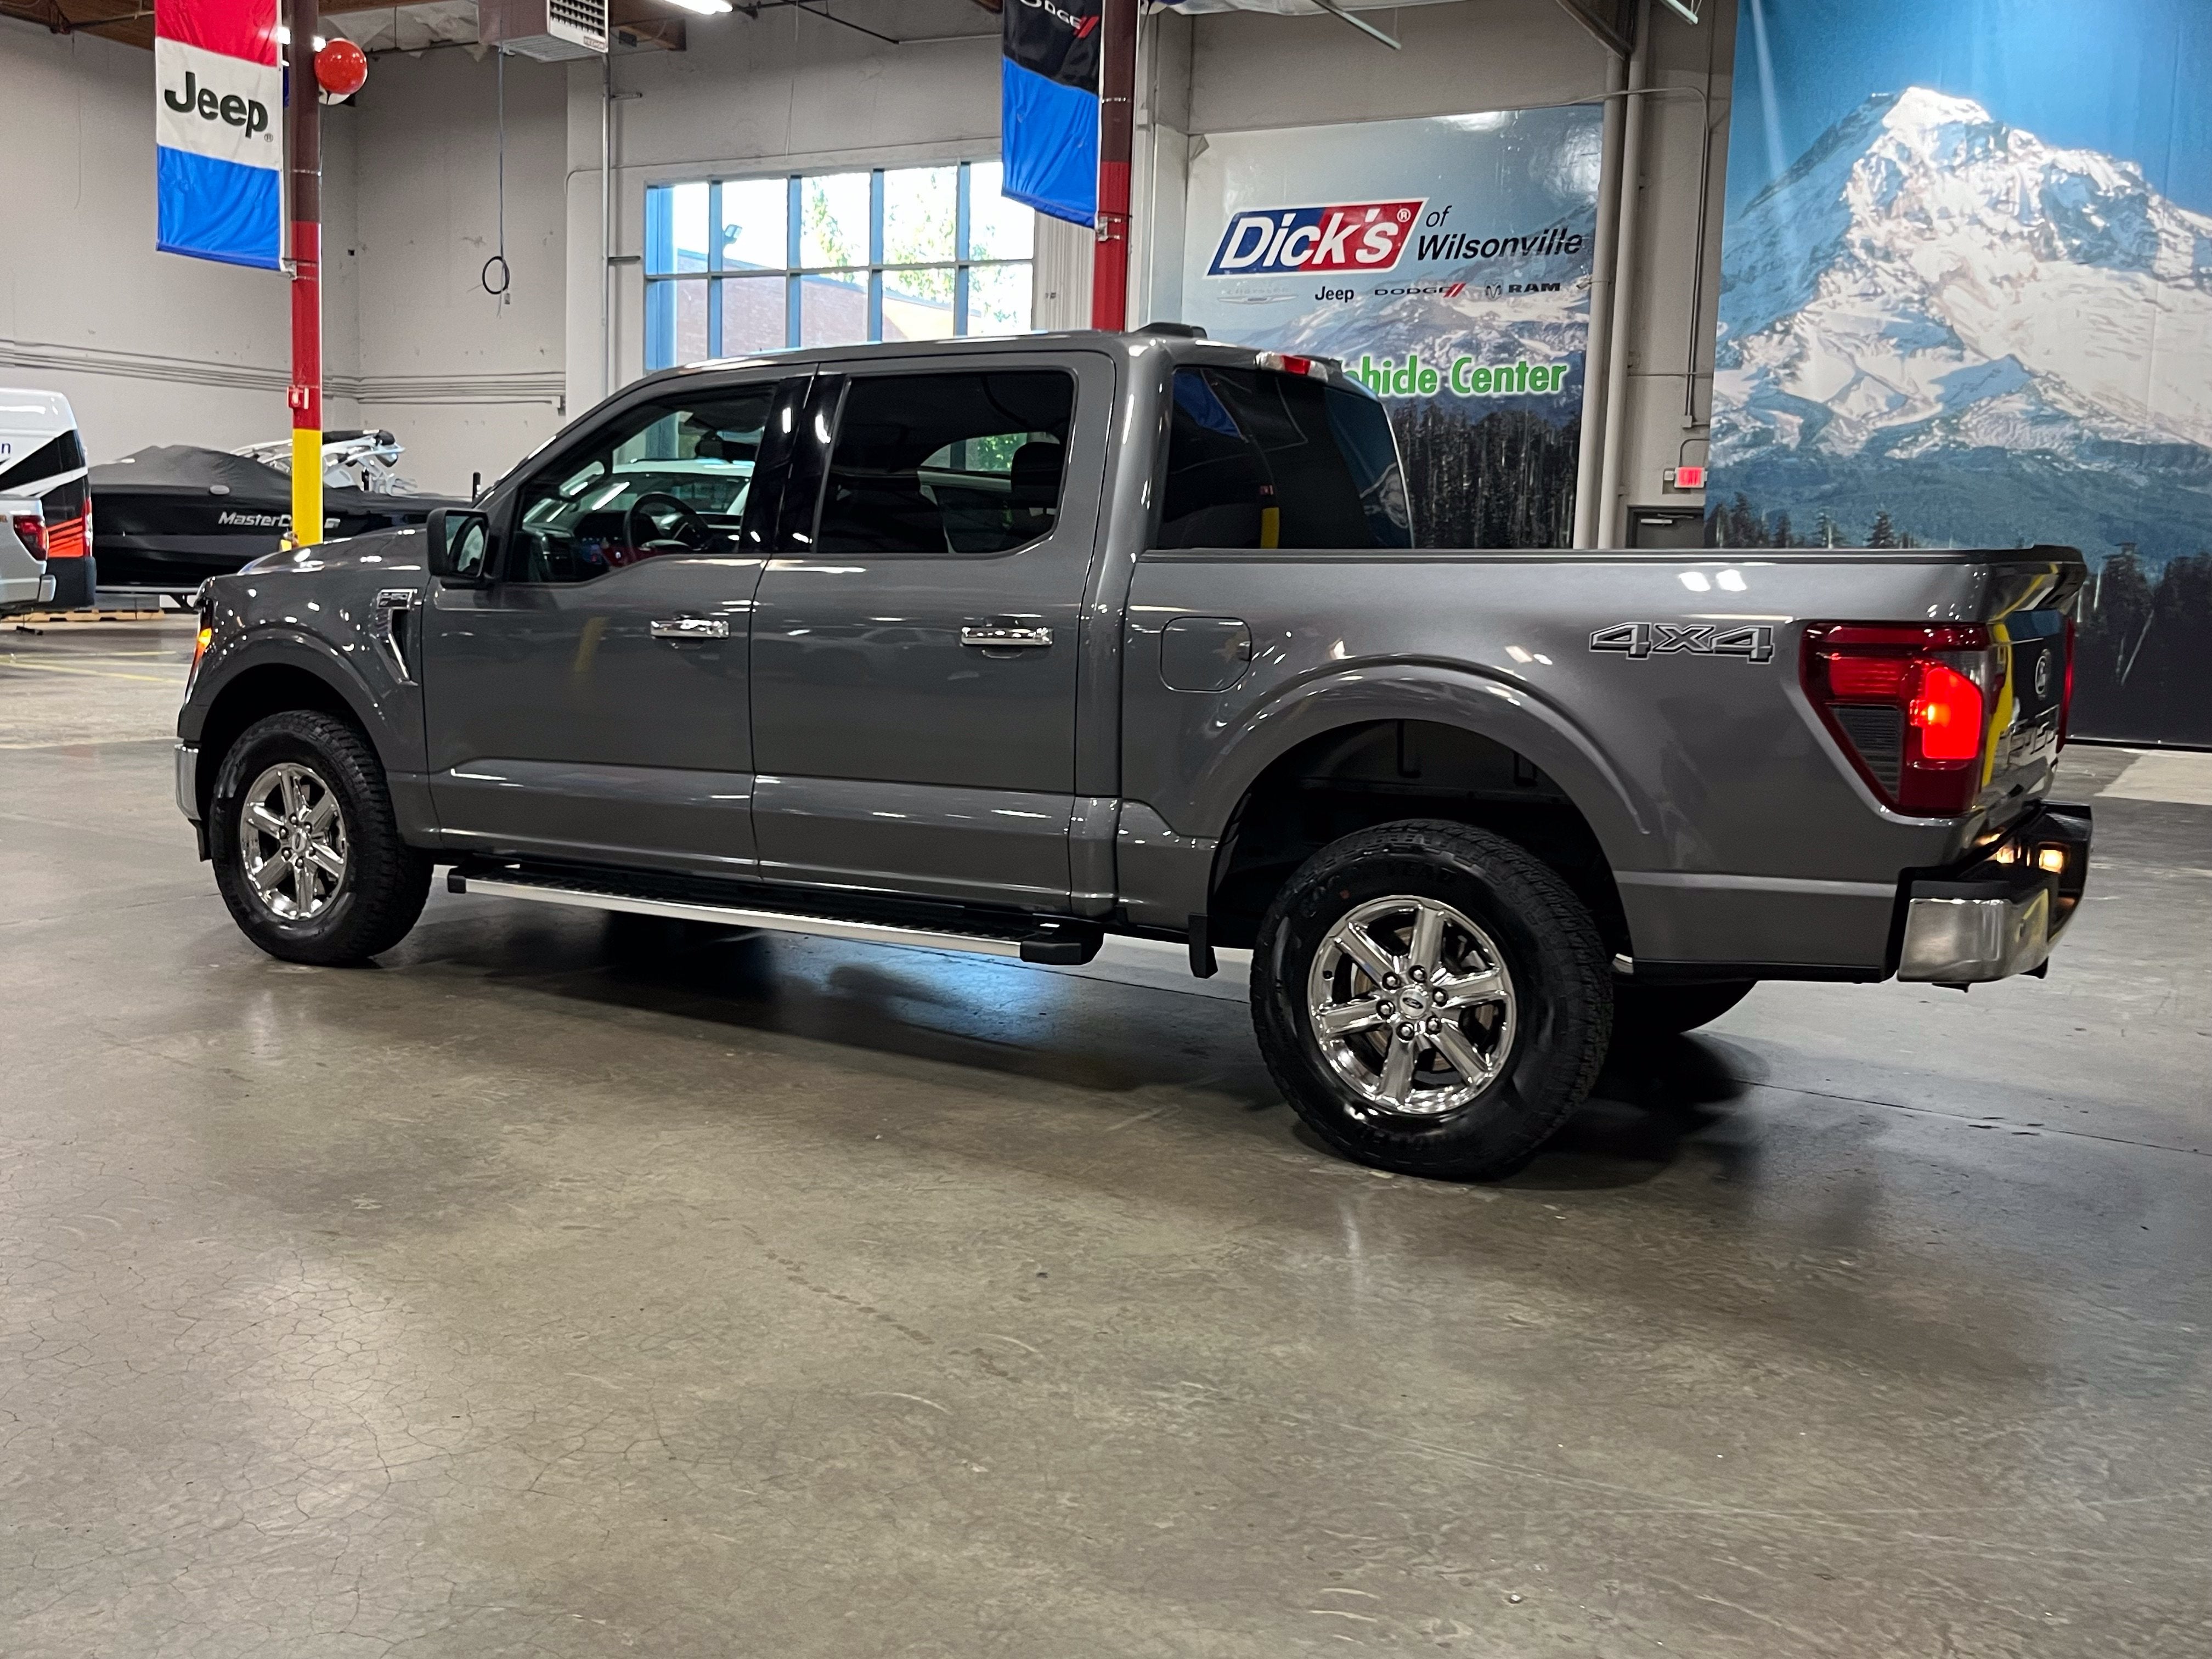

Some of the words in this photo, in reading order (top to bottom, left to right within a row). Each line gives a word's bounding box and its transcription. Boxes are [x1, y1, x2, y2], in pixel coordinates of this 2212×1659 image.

[164, 71, 268, 139] Jeep
[1219, 208, 1399, 269] Dick's
[1426, 205, 1453, 228] of
[1418, 227, 1583, 261] Wilsonville
[1314, 286, 1355, 303] Jeep
[1508, 283, 1561, 294] RAM
[1339, 355, 1438, 394] hicle
[1452, 357, 1567, 394] Center
